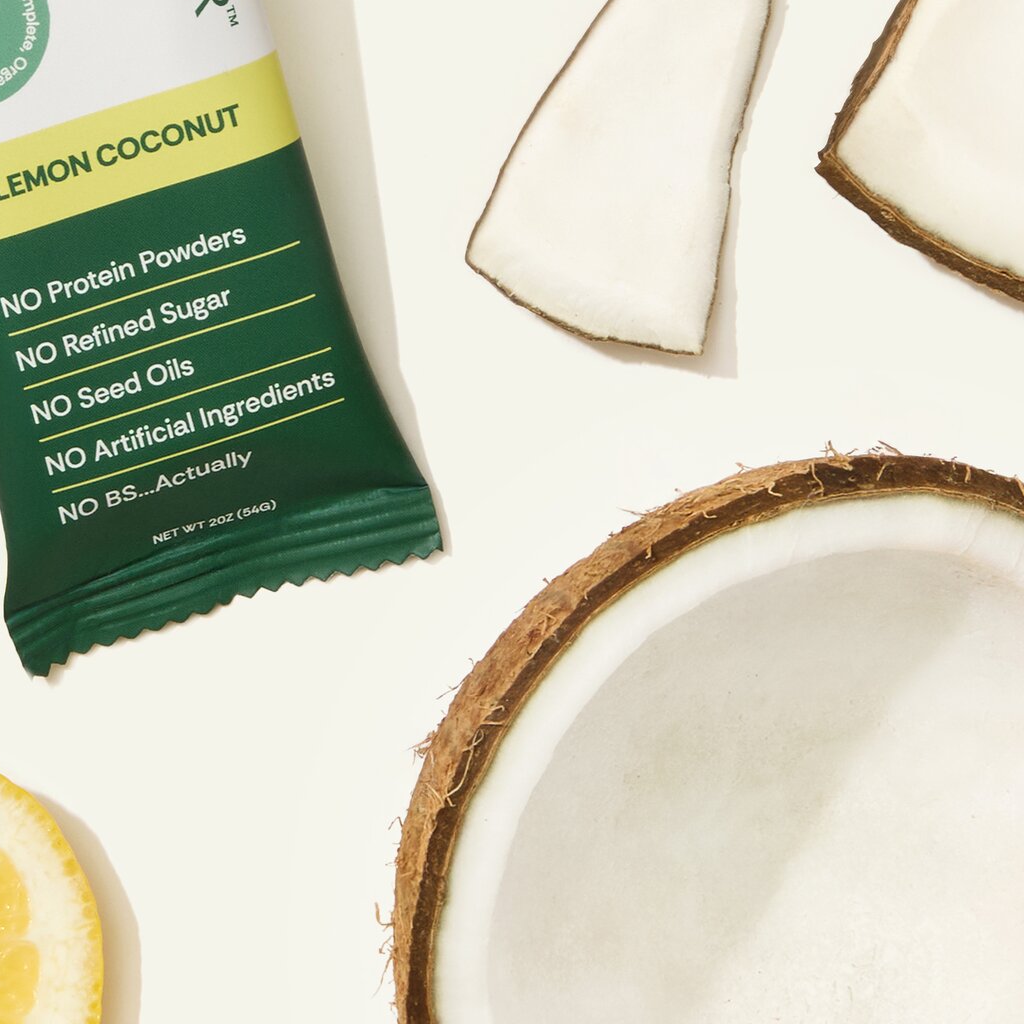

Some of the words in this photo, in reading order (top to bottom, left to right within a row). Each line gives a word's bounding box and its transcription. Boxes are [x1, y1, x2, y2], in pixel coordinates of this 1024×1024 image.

[96, 103, 240, 167] COCONUT
[0, 288, 42, 318] NO
[46, 260, 136, 304] Protein
[138, 228, 247, 274] Powders
[14, 341, 58, 372] NO
[61, 308, 156, 357] Refined
[159, 289, 231, 324] Sugar
[30, 394, 72, 425] NO
[77, 370, 142, 409] Seed
[146, 359, 195, 386] Oils
[44, 447, 87, 476] NO
[94, 411, 196, 462] Artificial
[198, 372, 336, 429] Ingredients
[57, 497, 99, 525] NO
[152, 527, 180, 545] NET
[181, 520, 206, 534] WT
[236, 499, 277, 520] (54G)
